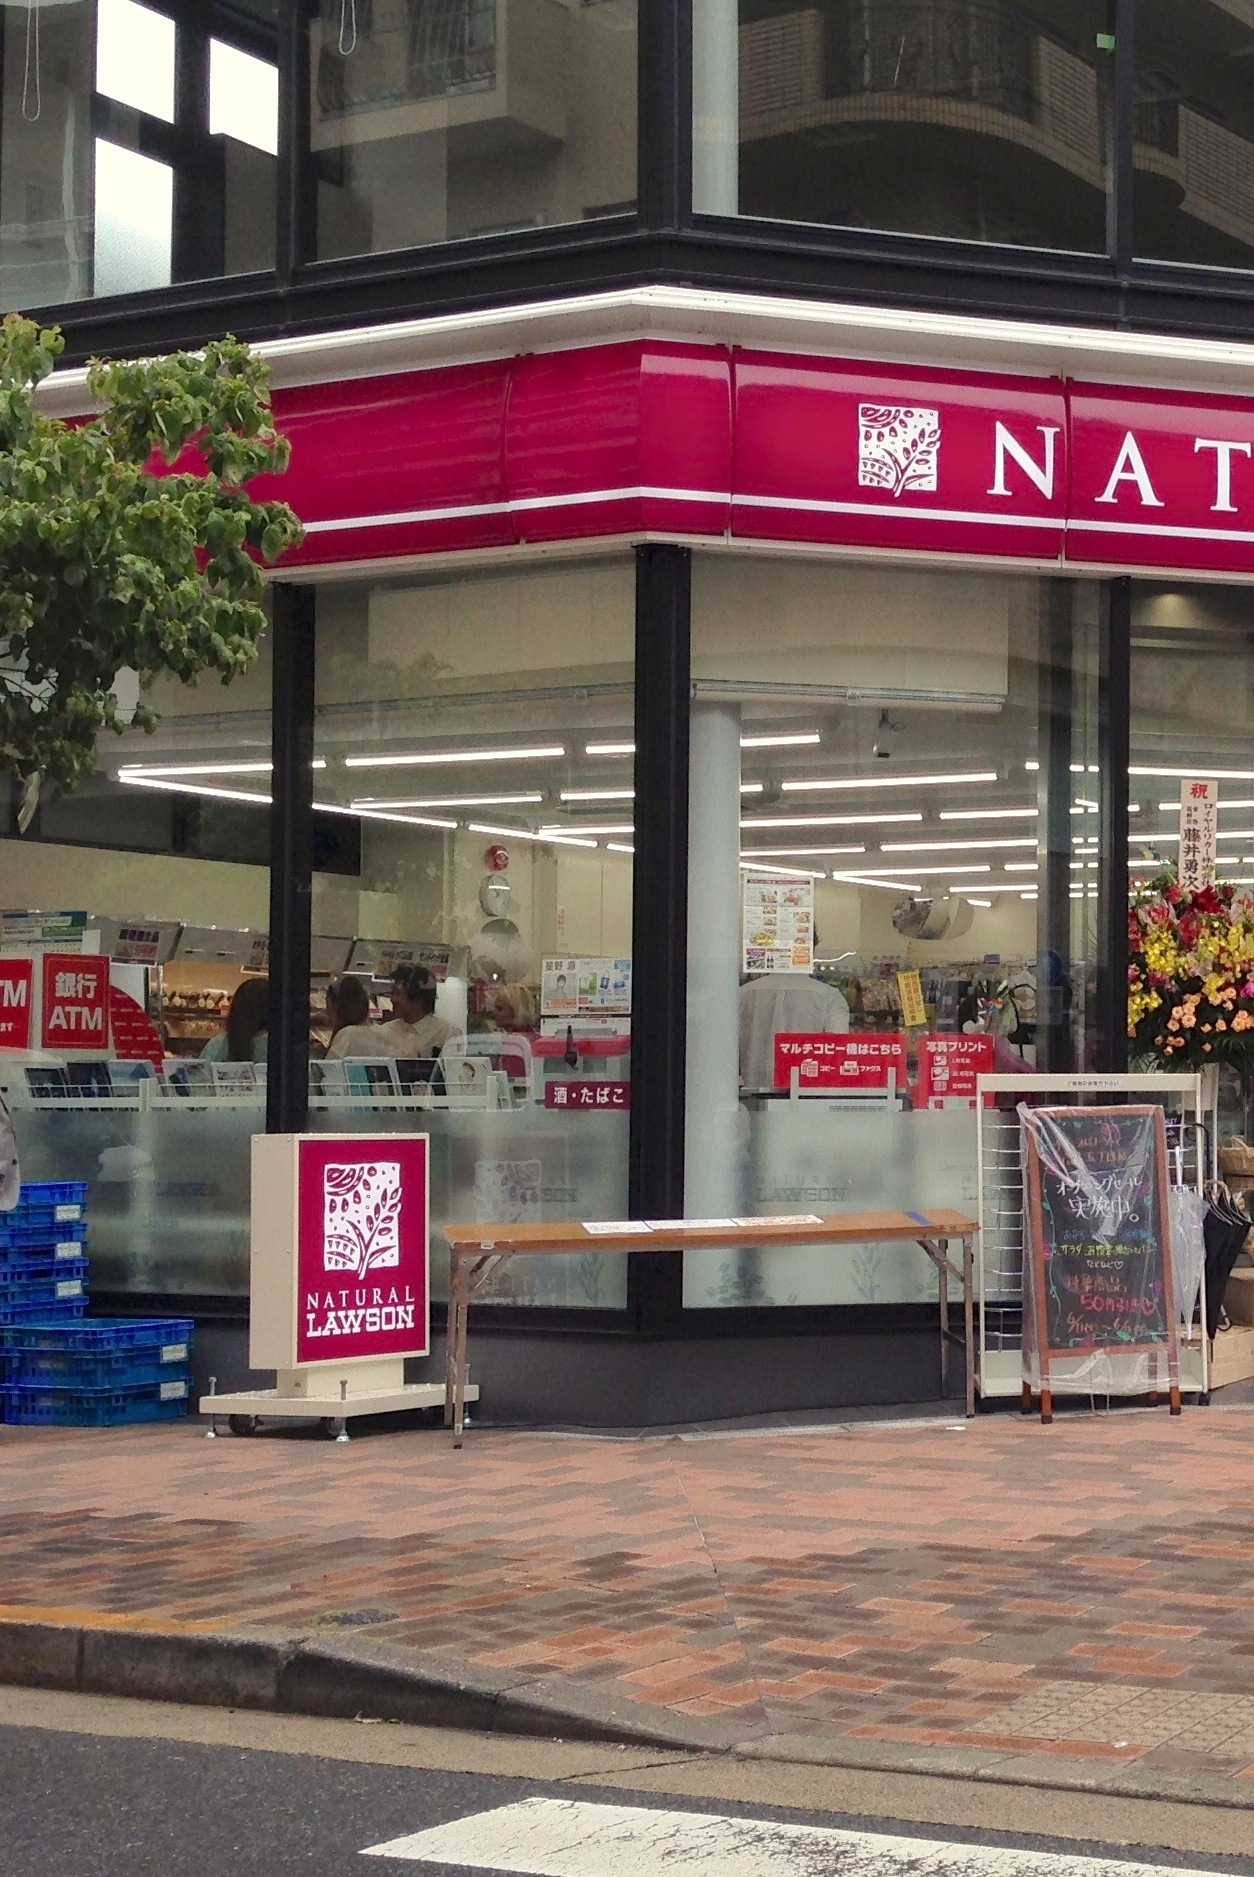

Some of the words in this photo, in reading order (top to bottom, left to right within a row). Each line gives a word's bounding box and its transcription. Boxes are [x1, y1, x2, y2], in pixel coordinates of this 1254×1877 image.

[1190, 783, 1209, 799] 祝
[55, 972, 97, 999] 銀行
[49, 1006, 103, 1031] ATM
[779, 1043, 902, 1056] マルチコピー機はこちら
[926, 1041, 988, 1053] 写真プリント
[554, 1087, 624, 1104] 酒・たばこ
[306, 1286, 415, 1310] NATURAL
[306, 1305, 415, 1338] LAWSON
